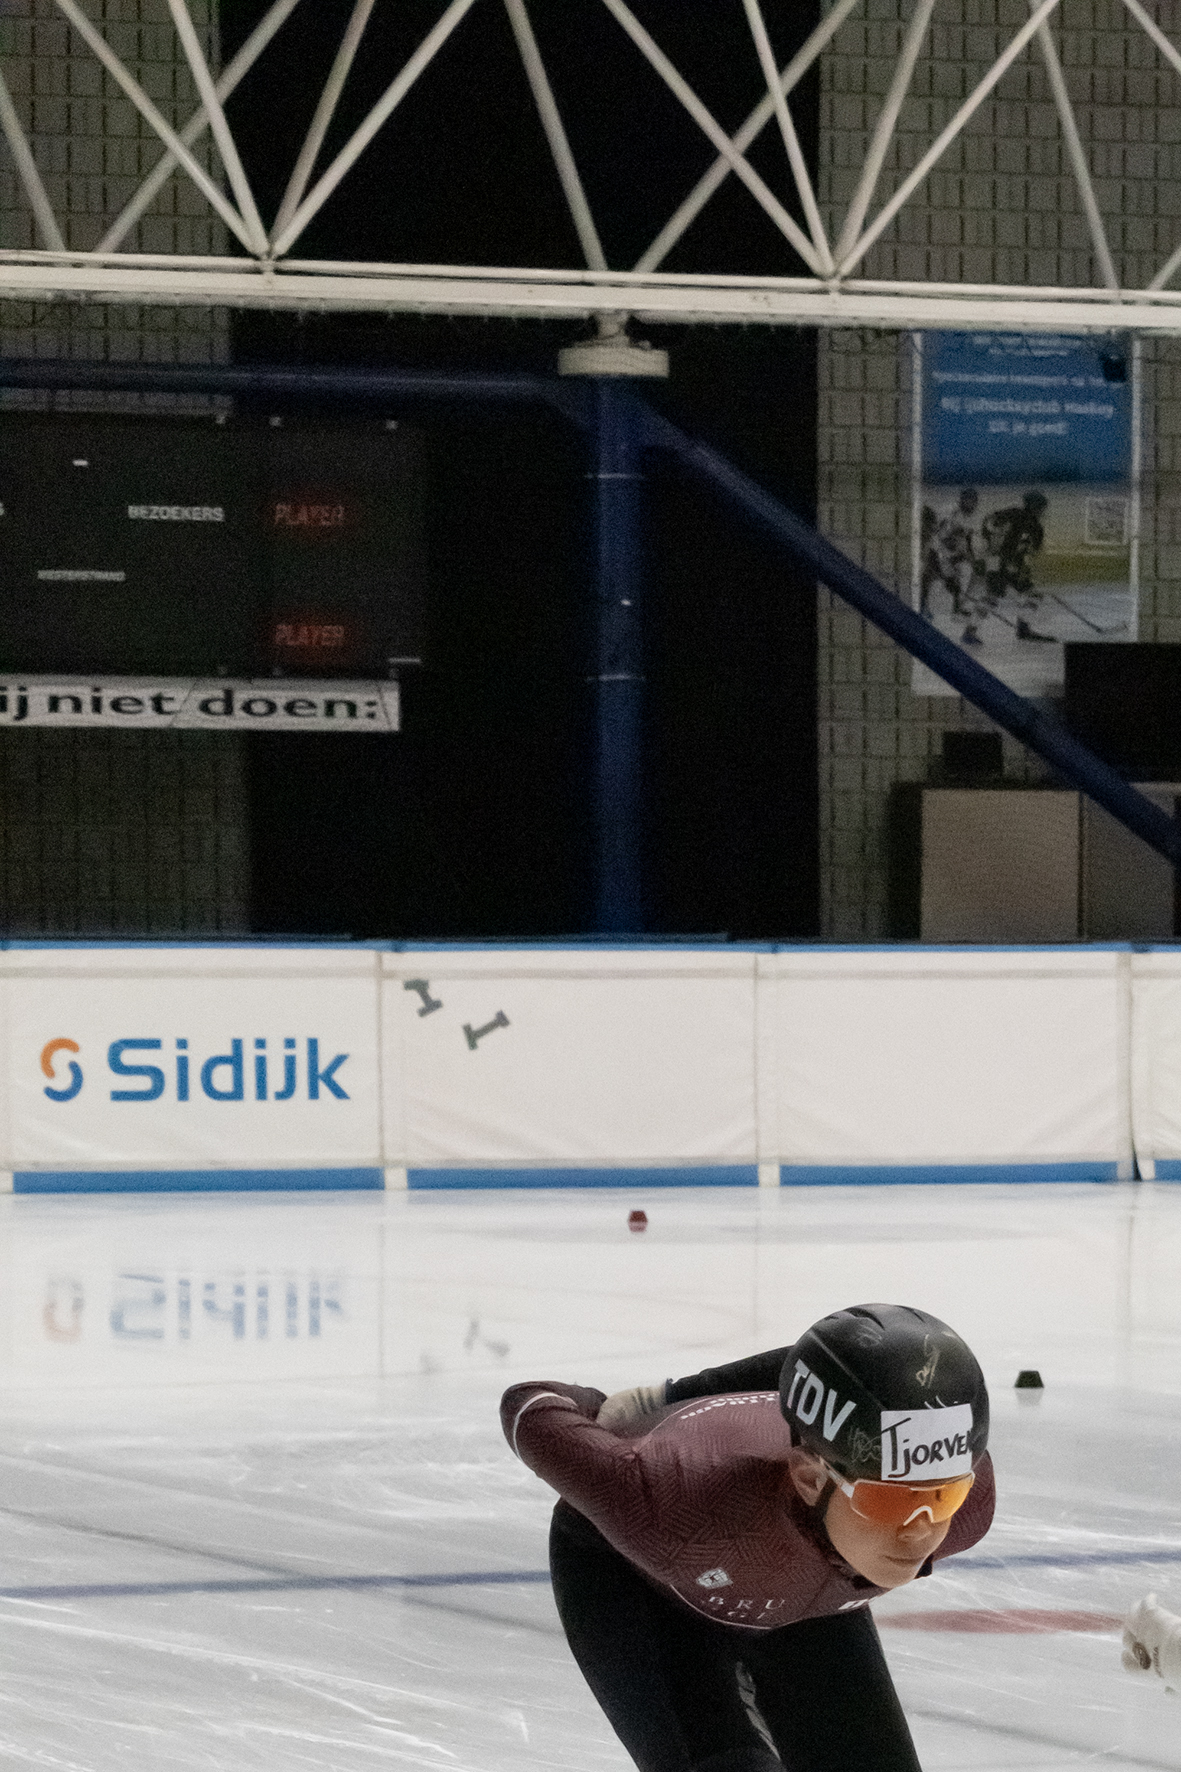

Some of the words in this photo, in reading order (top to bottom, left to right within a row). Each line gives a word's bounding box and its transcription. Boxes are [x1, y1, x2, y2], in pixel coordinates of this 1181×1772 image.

[128, 505, 224, 522] BEZOEKERS
[274, 504, 345, 526] PLAYER
[275, 624, 345, 646] PLAYER
[48, 687, 178, 716] niet
[199, 688, 377, 719] doen:
[107, 1038, 351, 1101] Sidijk
[787, 1358, 857, 1442] TDV
